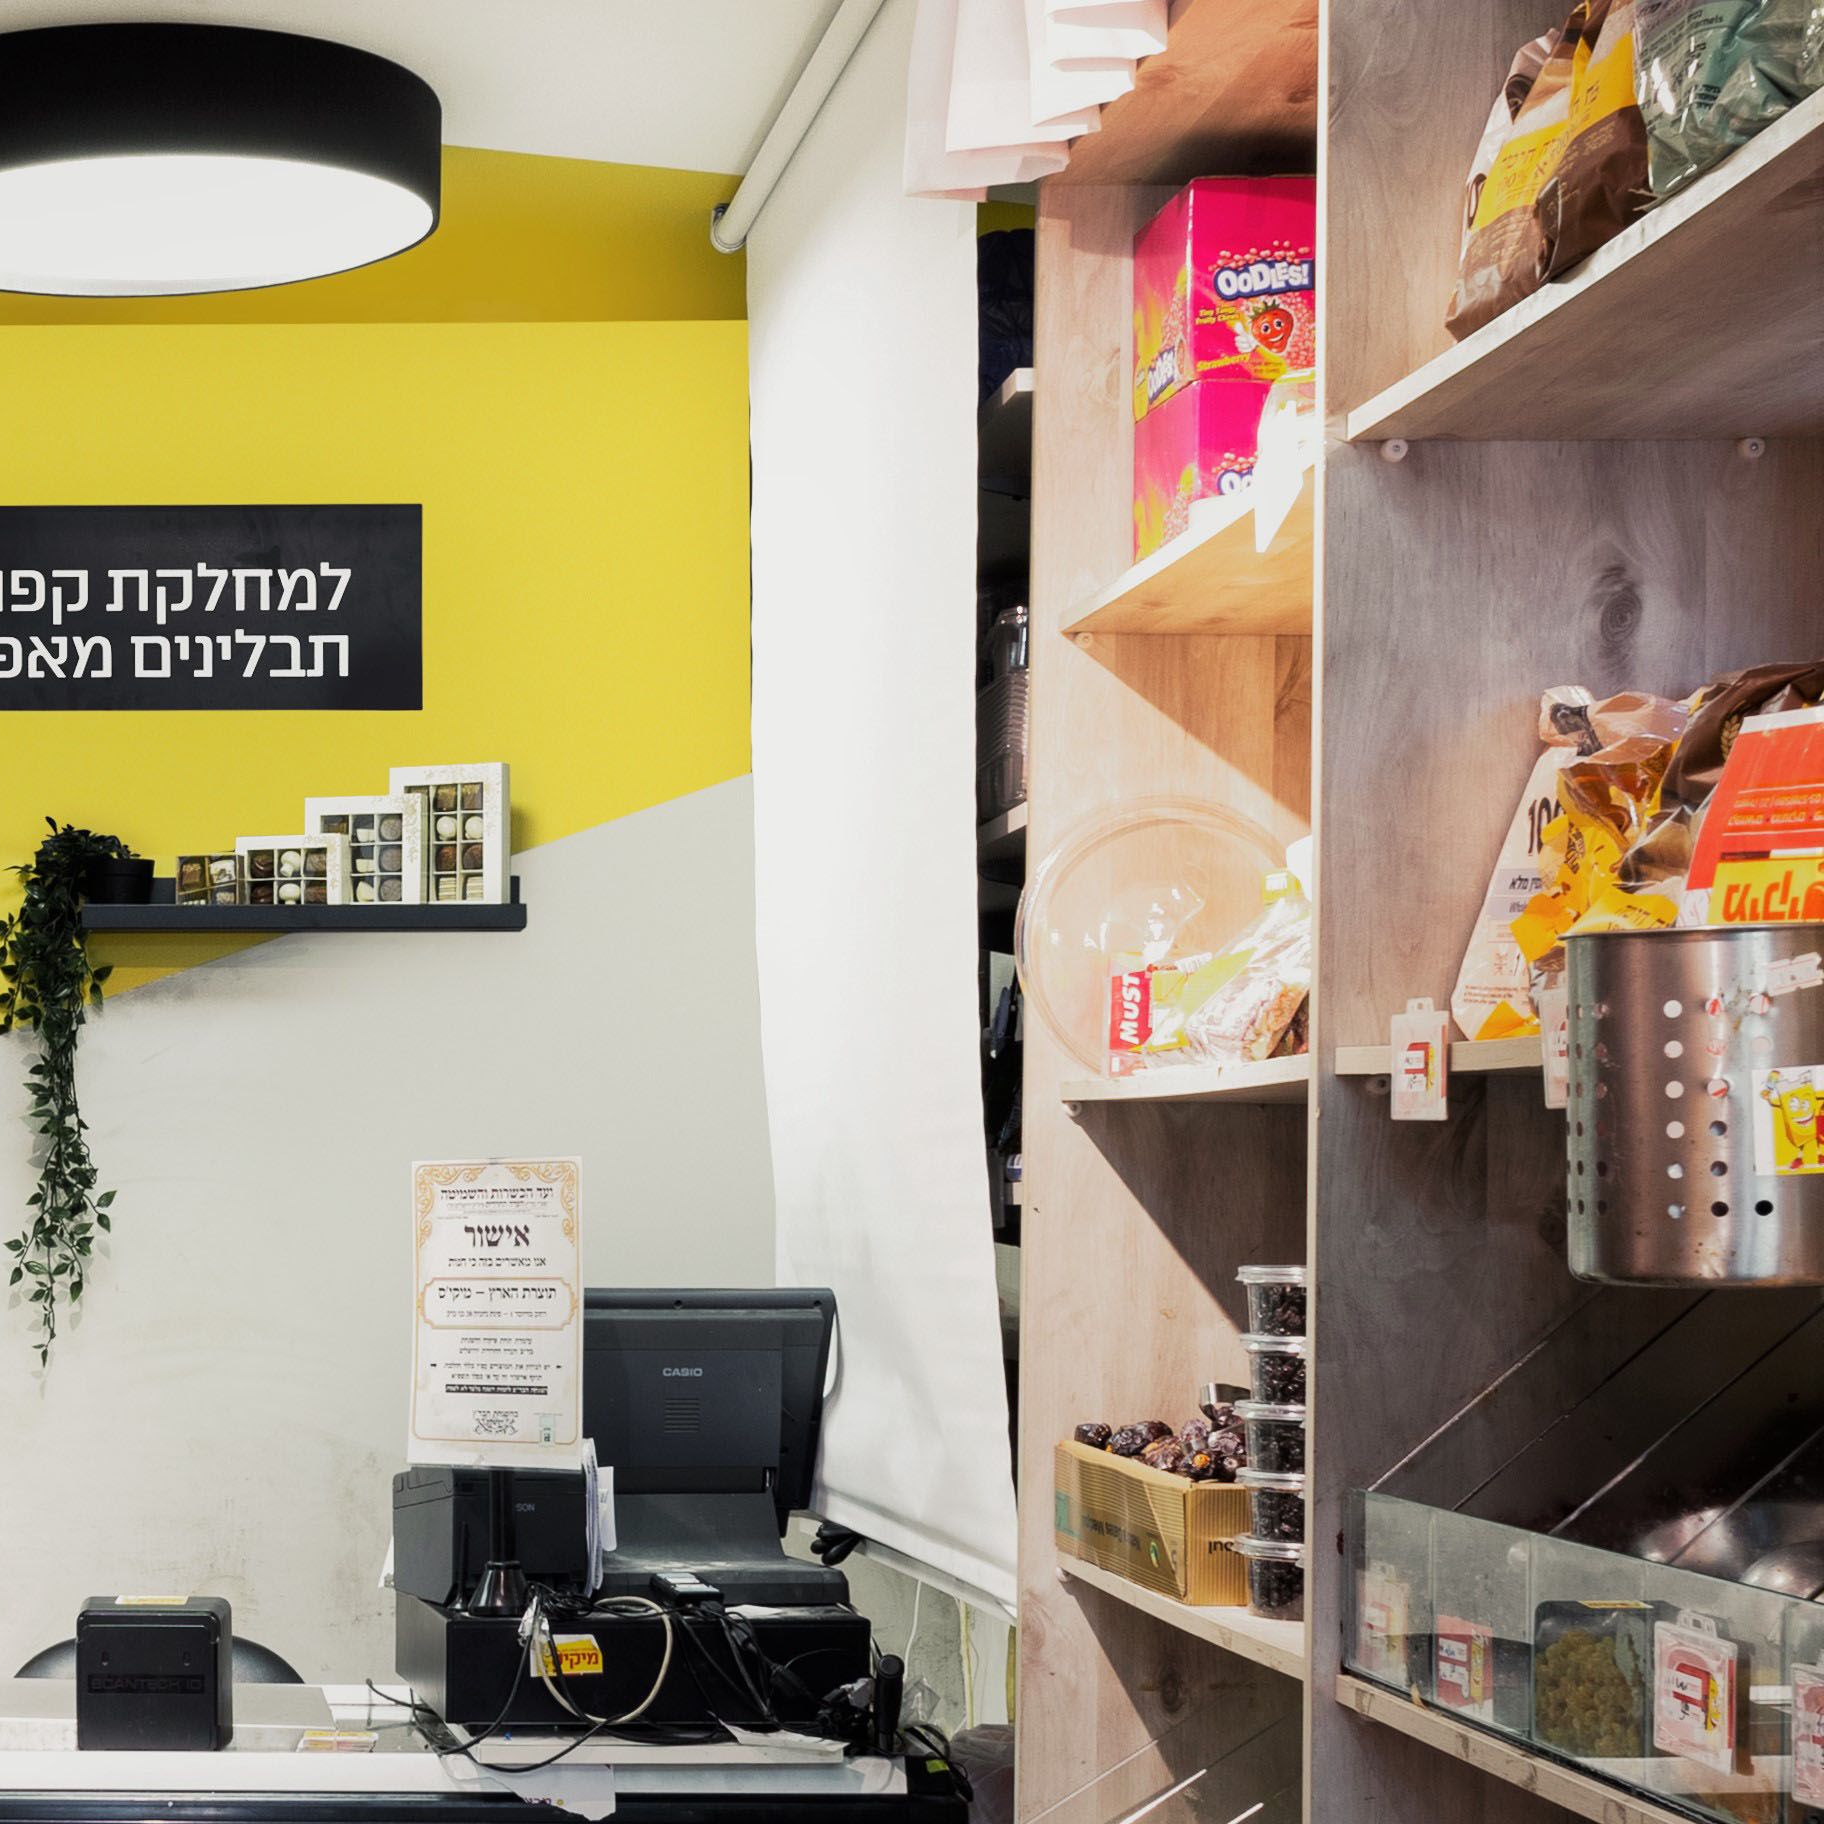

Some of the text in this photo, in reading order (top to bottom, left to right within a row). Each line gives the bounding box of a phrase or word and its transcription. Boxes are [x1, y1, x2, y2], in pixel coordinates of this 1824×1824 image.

[106, 562, 352, 624] למחלקת
[131, 628, 349, 678] תבלינים
[1119, 971, 1142, 1045] MUST
[464, 1224, 530, 1248] אישור
[488, 1287, 519, 1303] הארץ
[522, 1287, 558, 1300] תוצרת
[662, 1367, 703, 1378] CASIO
[514, 1503, 536, 1513] SON
